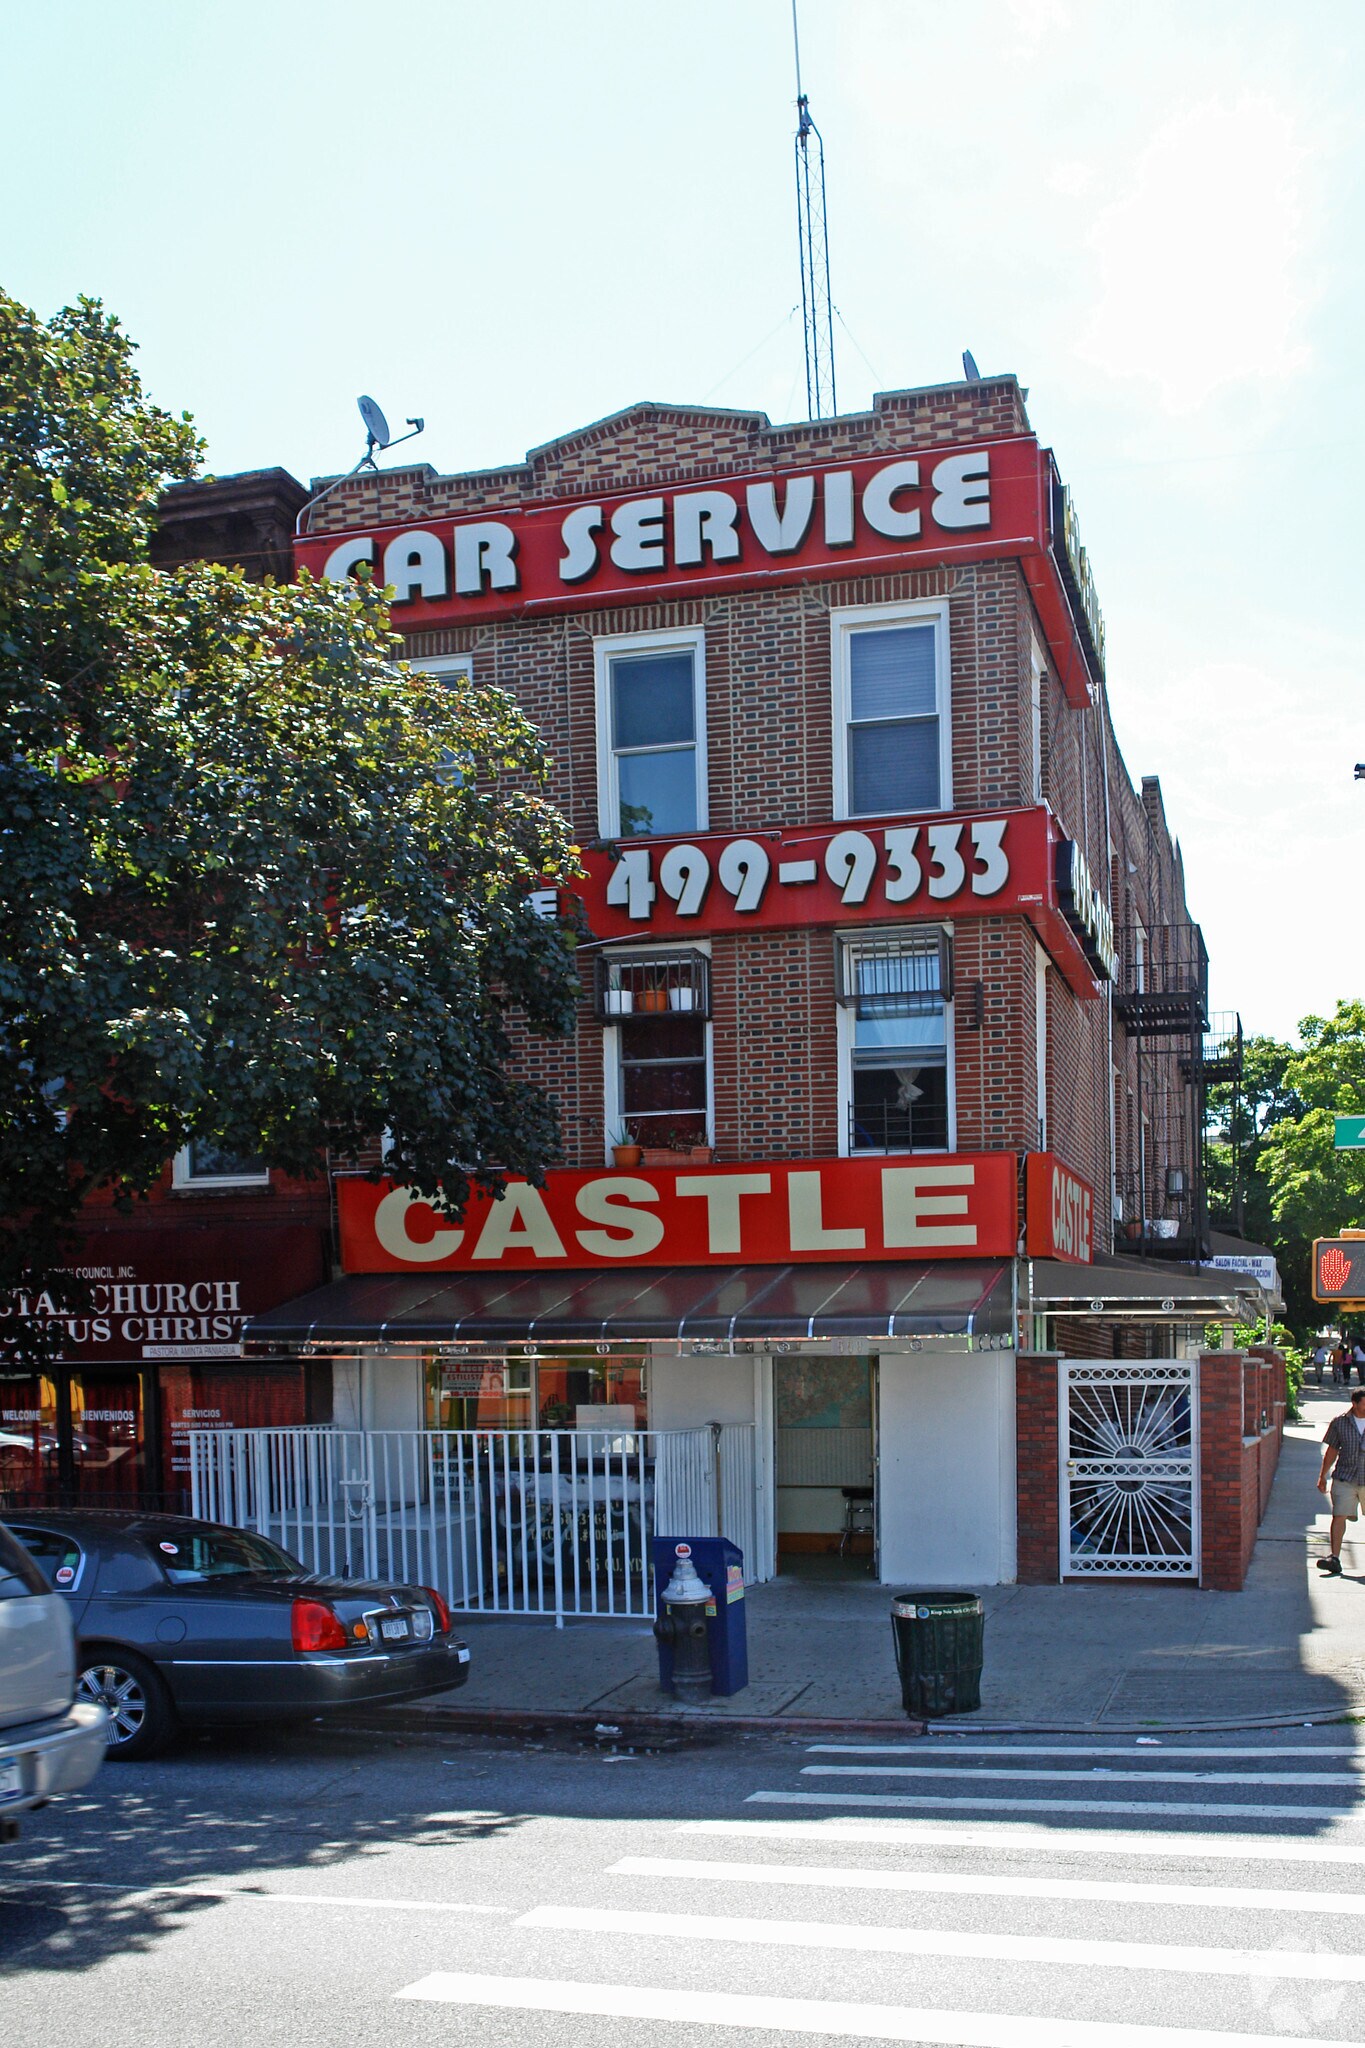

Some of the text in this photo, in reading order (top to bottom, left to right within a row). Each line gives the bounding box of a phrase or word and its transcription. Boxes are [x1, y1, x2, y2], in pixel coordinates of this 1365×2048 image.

[323, 521, 518, 602] CAR
[559, 451, 992, 584] SERVICE
[607, 820, 1010, 920] 499-9333
[374, 1164, 978, 1263] CASTLE
[1052, 1166, 1091, 1264] CASTLE
[75, 1266, 115, 1279] COUNCIL
[90, 1282, 240, 1315] CHURCH
[149, 1347, 178, 1357] PASTORA
[2, 1410, 41, 1421] WELCOME
[80, 1410, 134, 1422] BIENVENIDOS
[182, 1409, 221, 1418] SERVICIOS
